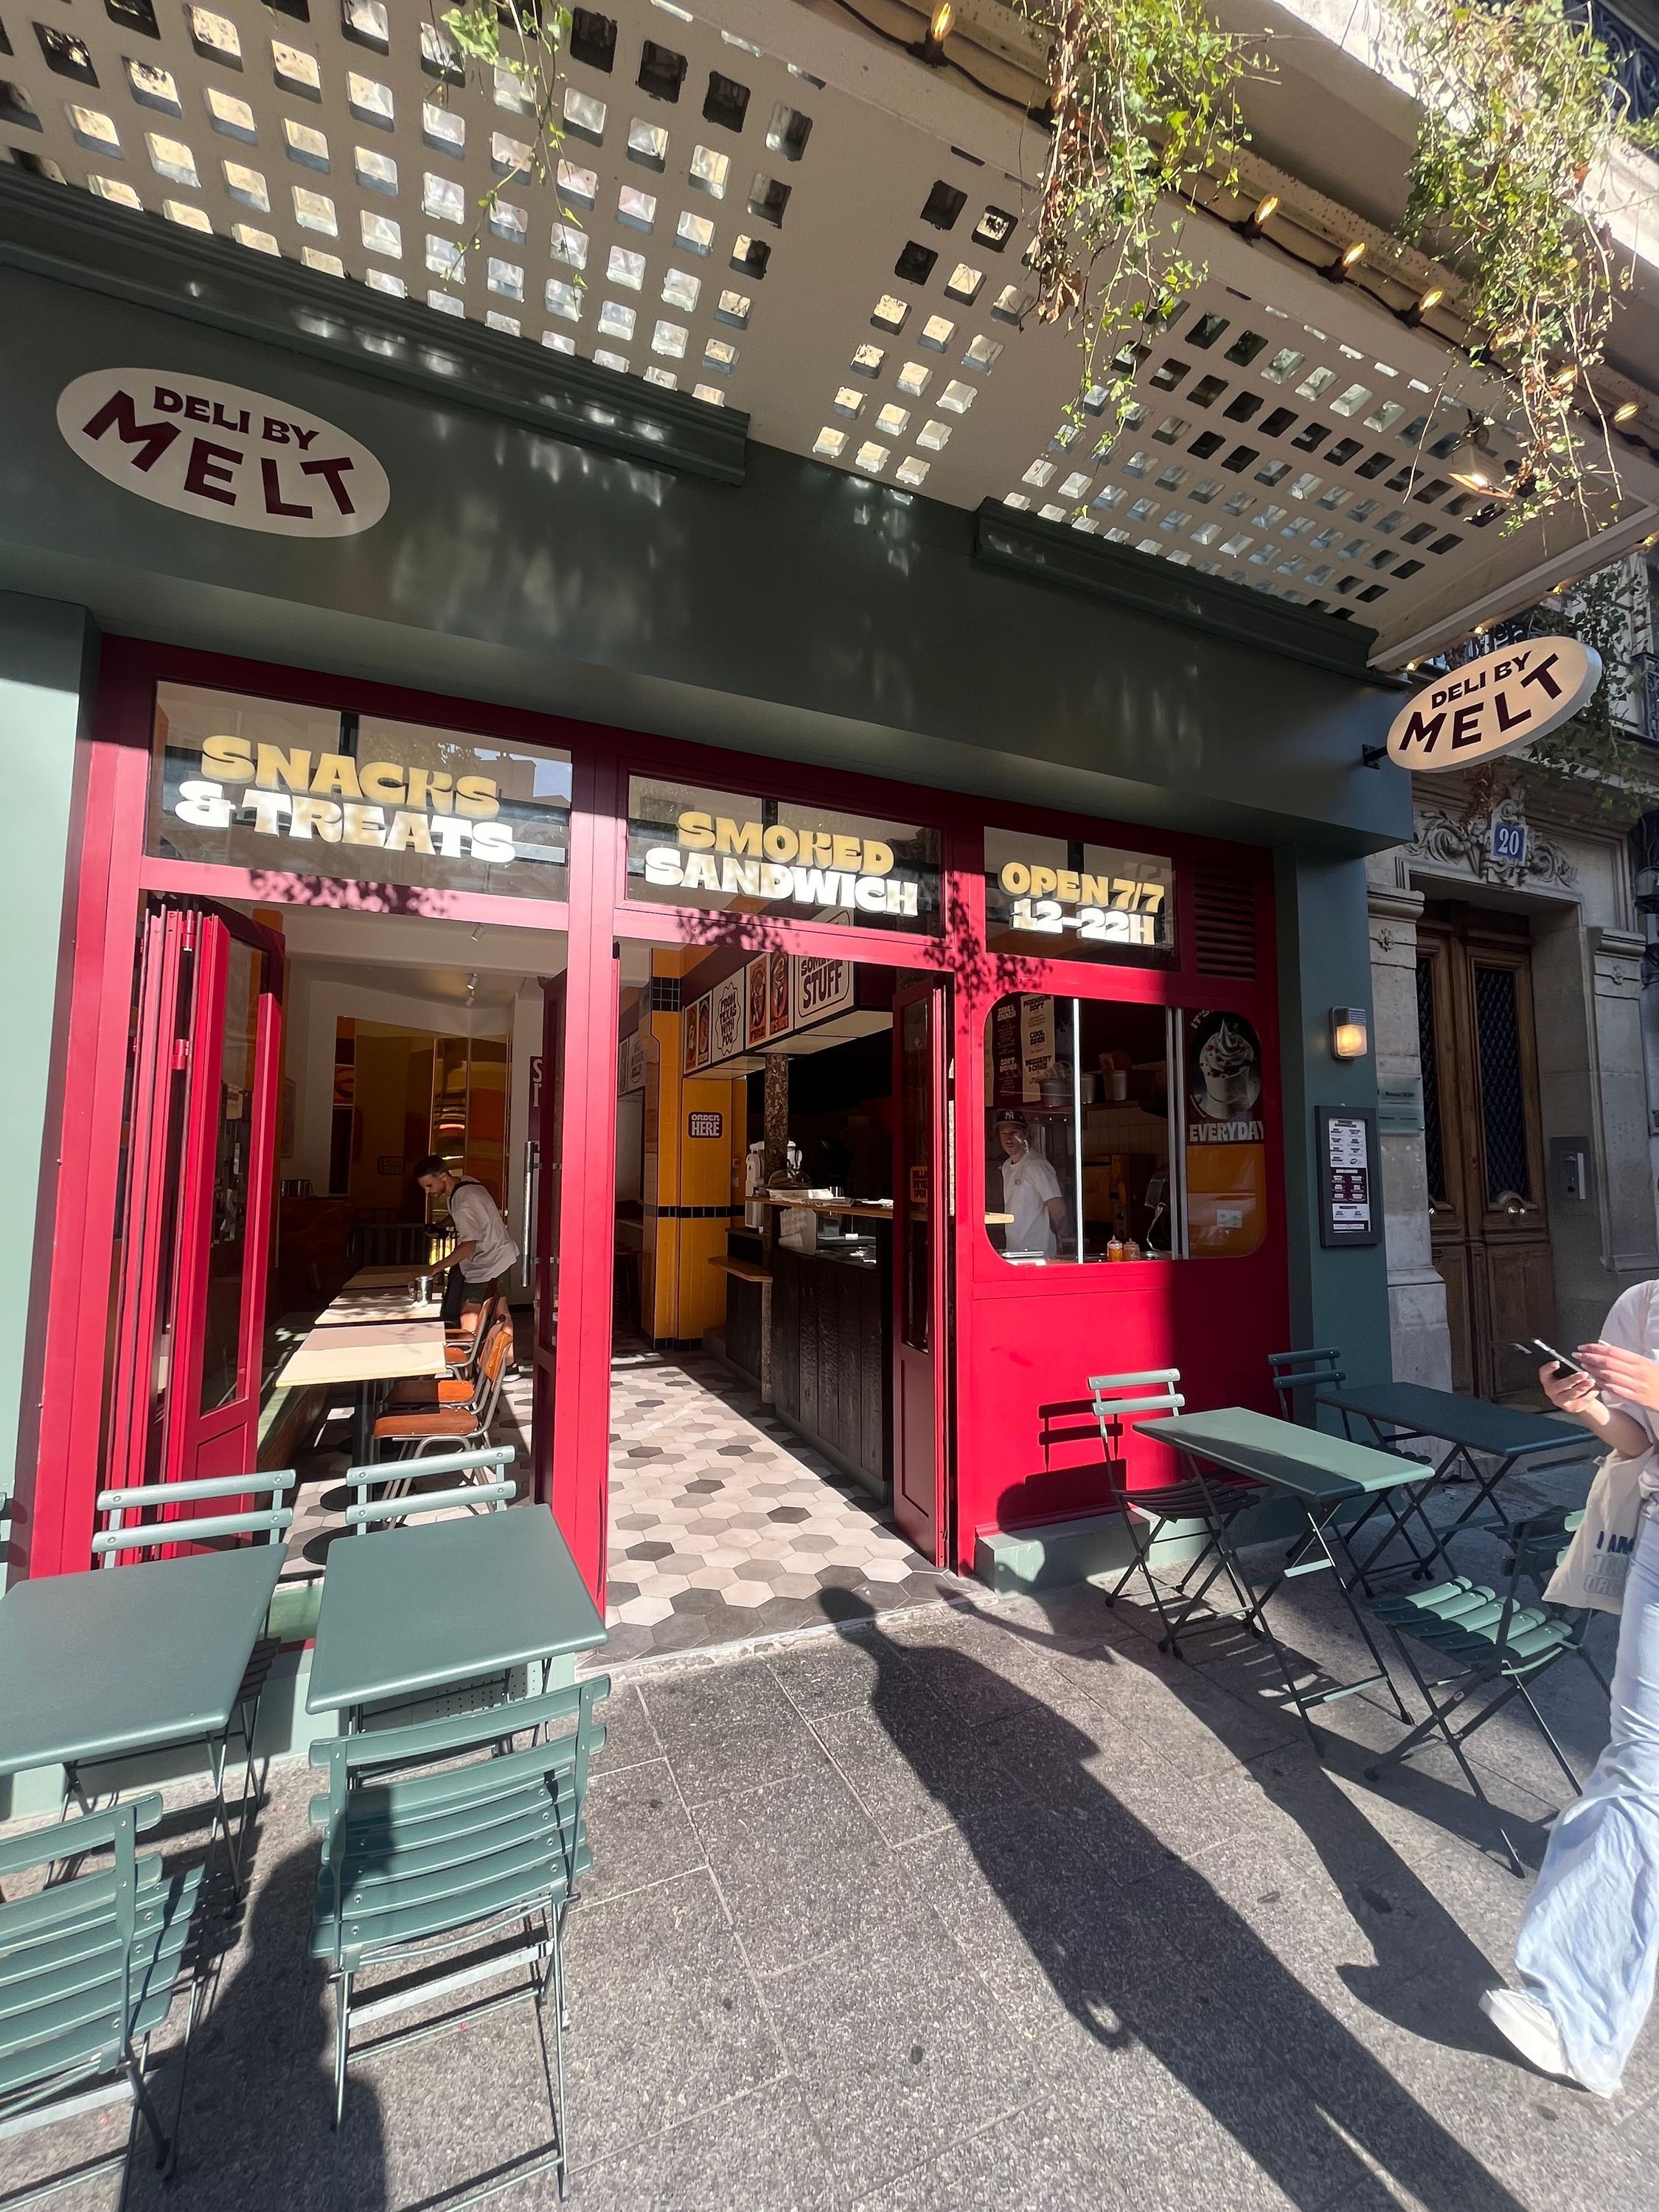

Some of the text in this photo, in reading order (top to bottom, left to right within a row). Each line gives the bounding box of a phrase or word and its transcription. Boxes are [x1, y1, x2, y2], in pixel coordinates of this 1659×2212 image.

[153, 386, 320, 451] DELI BY
[82, 389, 356, 519] MELT
[1399, 653, 1562, 753] MELT
[1431, 650, 1532, 709] DELI BY
[201, 735, 501, 819] SNACKS
[175, 780, 516, 863] & TREATS
[678, 811, 894, 875] SMOKED
[1498, 828, 1519, 855] 20
[645, 847, 918, 917] SANDWICH
[1001, 862, 1165, 913] OPEN 7/7
[1009, 898, 1155, 945] 12-22H
[721, 992, 736, 1013] FROM
[804, 960, 843, 1009] STUFF
[720, 1004, 737, 1024] TEXAS
[721, 1018, 734, 1036] WITH
[1191, 1009, 1209, 1029] IT'S
[692, 1121, 720, 1135] HERE
[1189, 1121, 1265, 1141] EVERYDAY
